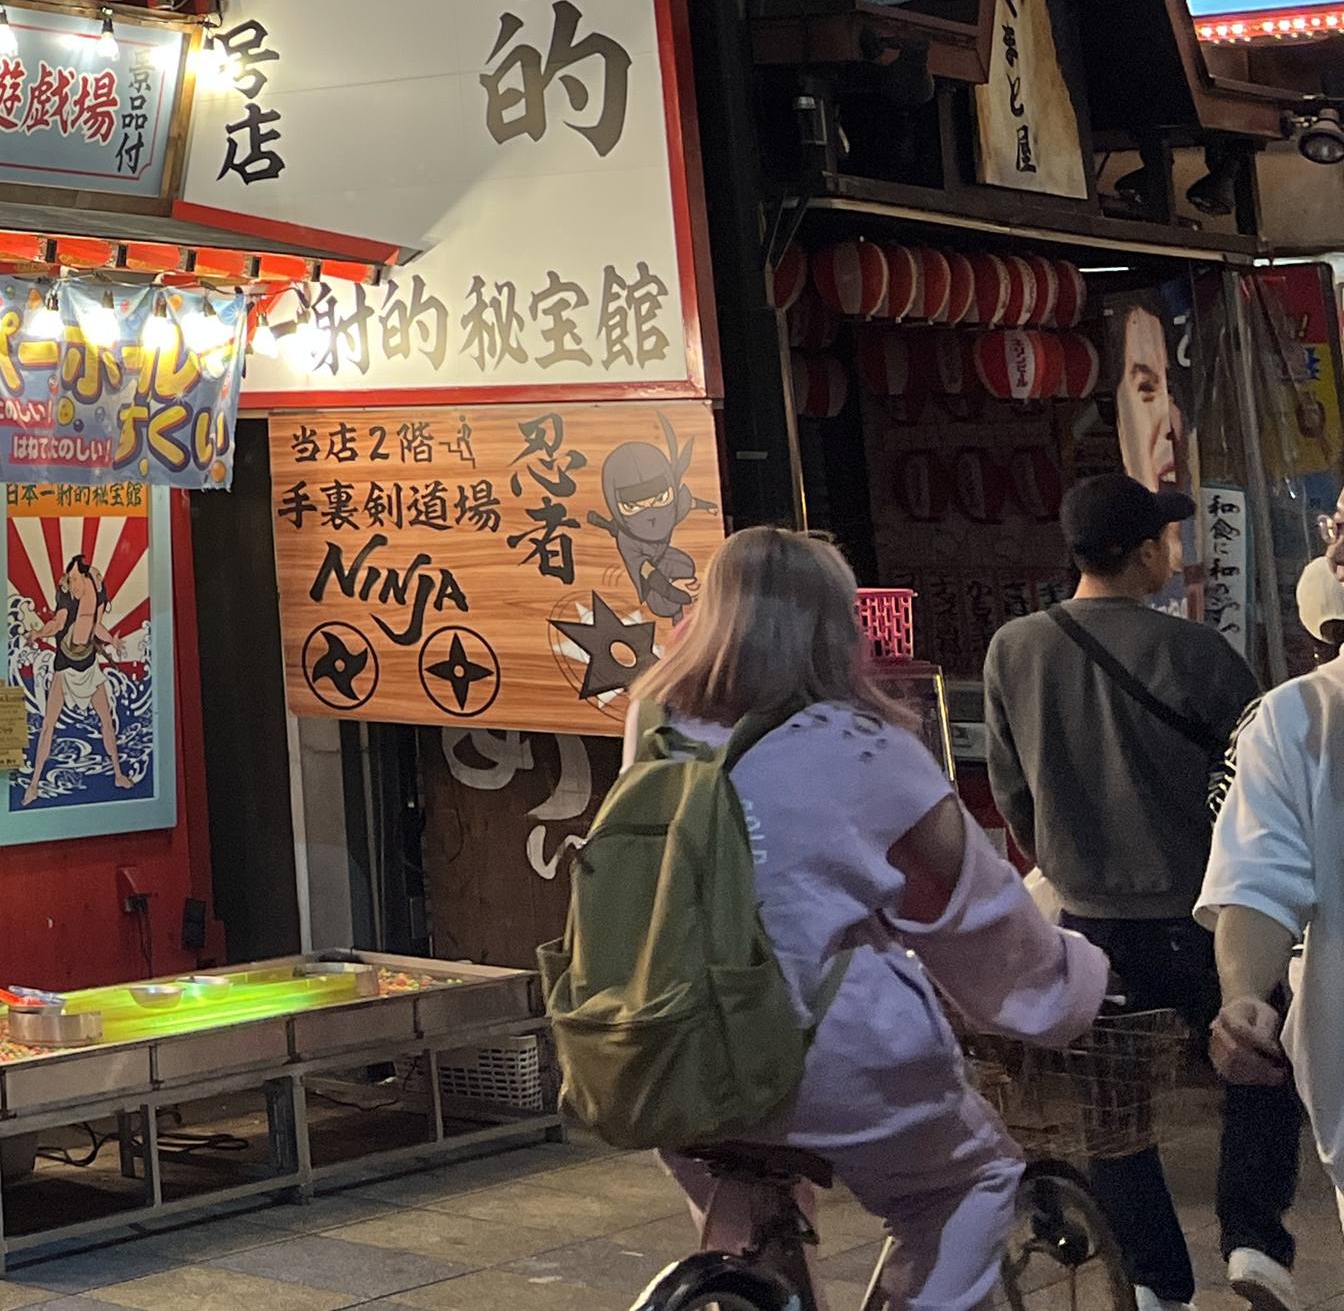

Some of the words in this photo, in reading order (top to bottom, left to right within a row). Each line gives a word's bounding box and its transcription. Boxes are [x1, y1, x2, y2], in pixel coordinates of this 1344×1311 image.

[290, 422, 434, 466] 当店2階
[6, 481, 143, 508] 日本一射的秘宝館
[277, 478, 502, 533] 手裏剣道場
[506, 412, 588, 586] 忍者
